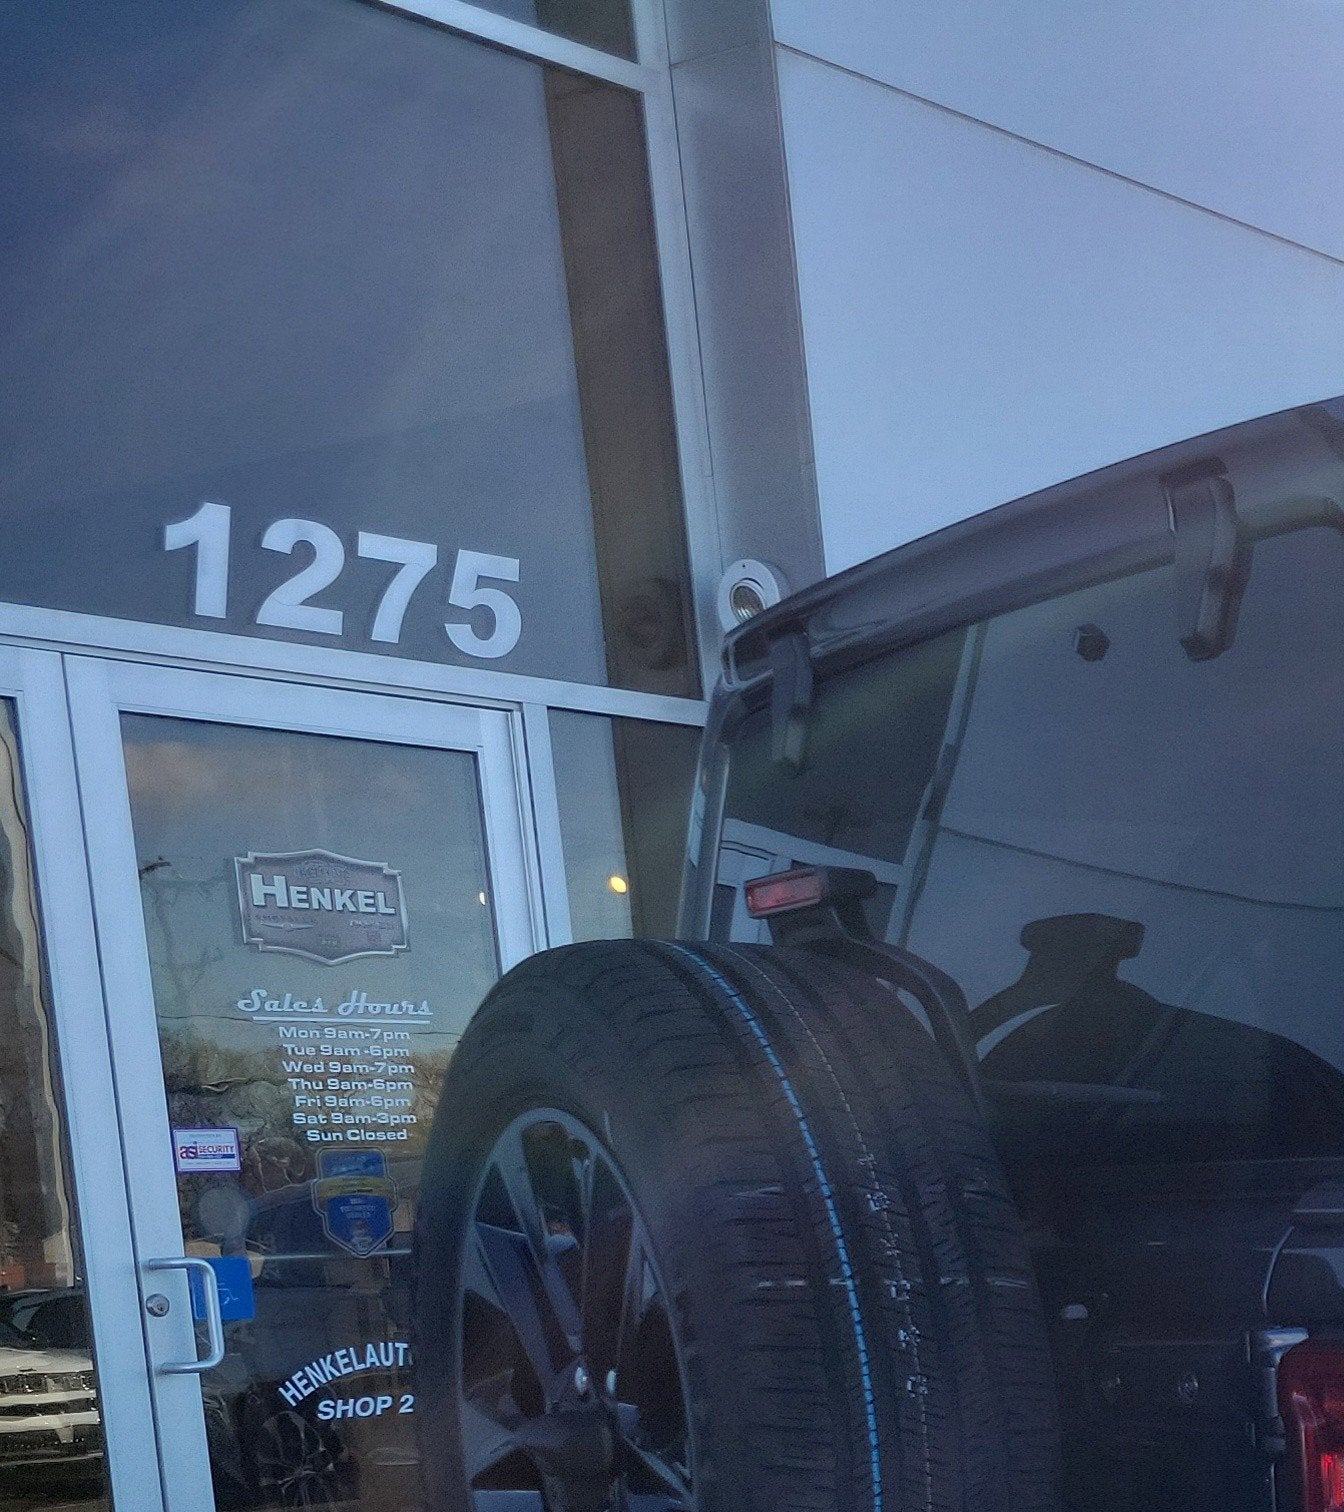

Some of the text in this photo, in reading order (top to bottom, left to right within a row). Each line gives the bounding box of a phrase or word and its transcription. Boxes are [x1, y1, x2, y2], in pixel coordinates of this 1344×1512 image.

[163, 501, 522, 659] 1275
[237, 988, 434, 1016] Sales Hours
[278, 1026, 411, 1043] Mon 9am-7pm
[282, 1043, 316, 1056] Tue
[282, 1061, 415, 1076] Wed 9am-7pm
[287, 1077, 413, 1092] Thu 9am-6pm
[294, 1095, 412, 1110] Fri 9am-6pm
[292, 1112, 418, 1126] Sat 9am-3pm
[306, 1128, 408, 1141] Sun Closed
[278, 1341, 414, 1408] HENKELAUT
[317, 1395, 393, 1420] SHOP
